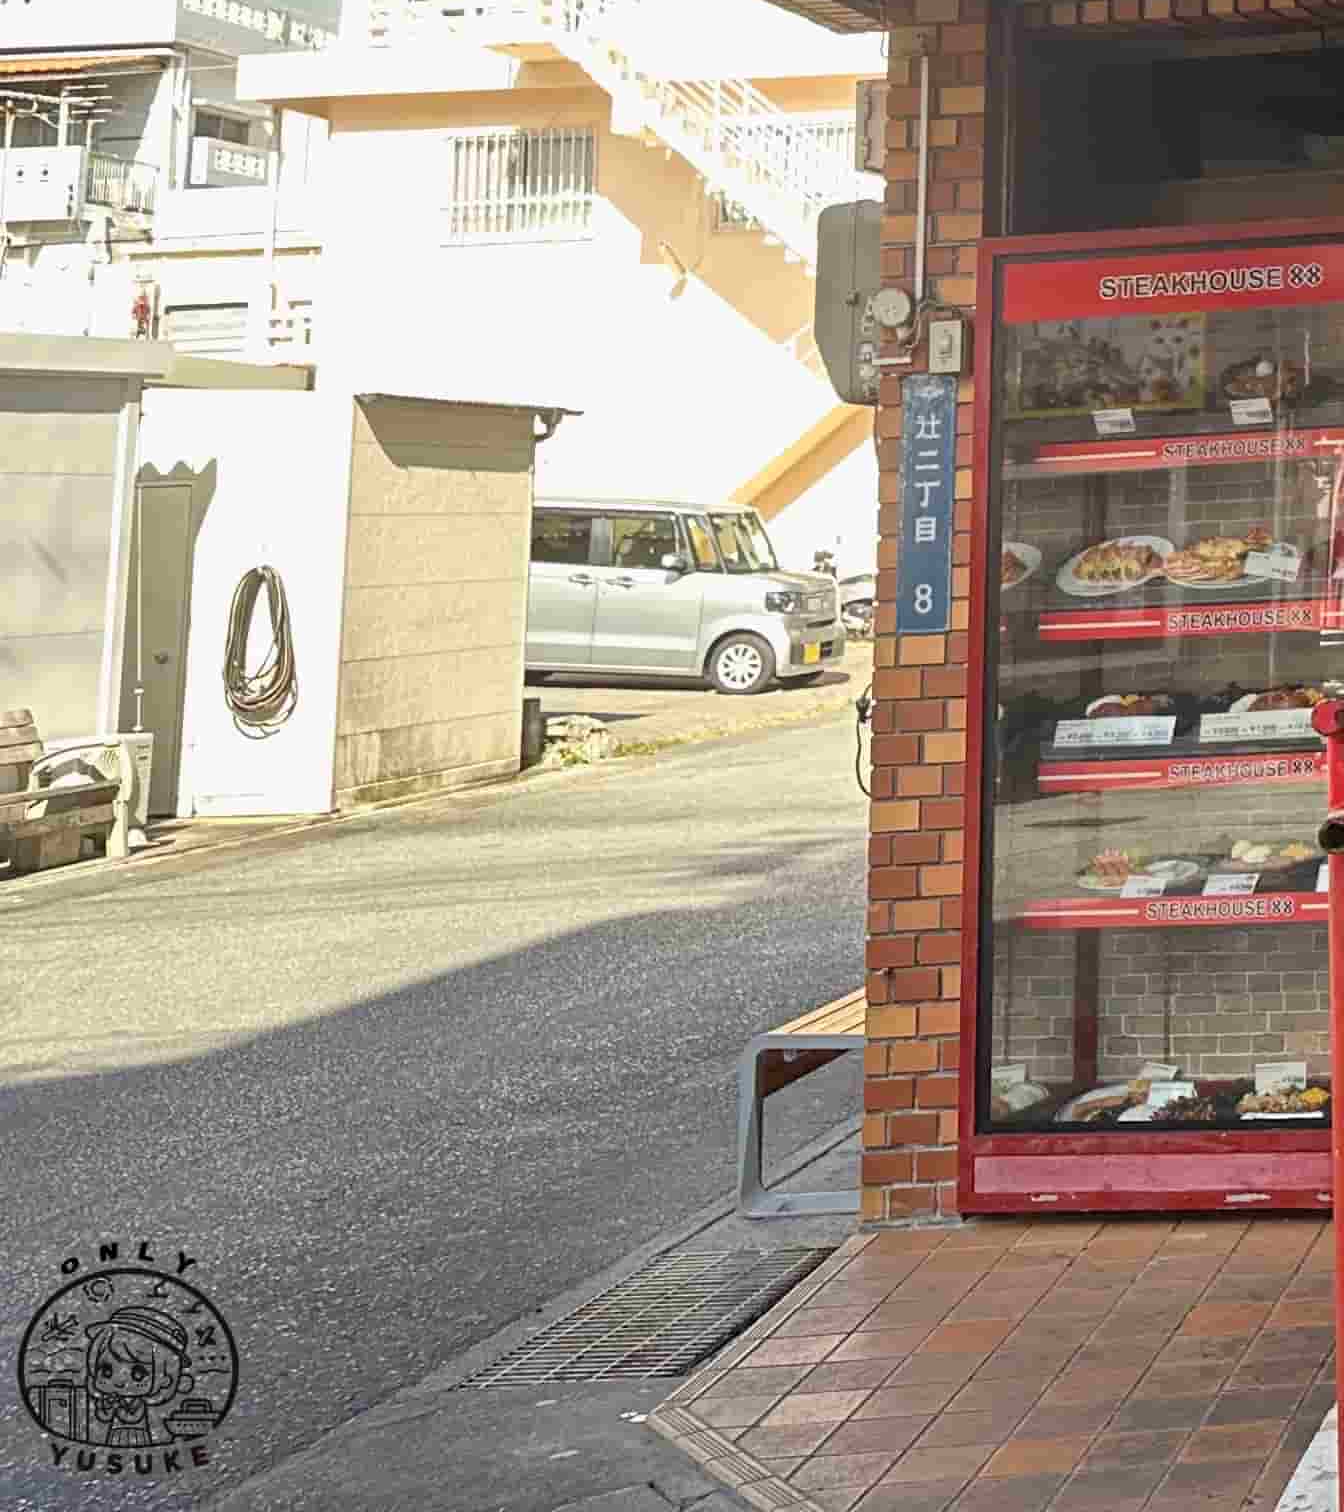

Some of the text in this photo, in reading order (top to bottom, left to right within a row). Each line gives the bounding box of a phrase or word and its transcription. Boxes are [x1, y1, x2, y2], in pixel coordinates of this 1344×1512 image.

[1099, 263, 1323, 300] STEAKHOUSE 88
[1163, 439, 1281, 458] STEAKHOUSE
[913, 583, 933, 614] 8
[1168, 609, 1287, 630] STEAKHOUSE
[1168, 760, 1288, 779] STEAKHOUSE
[1146, 900, 1266, 920] STEAKHOUSE
